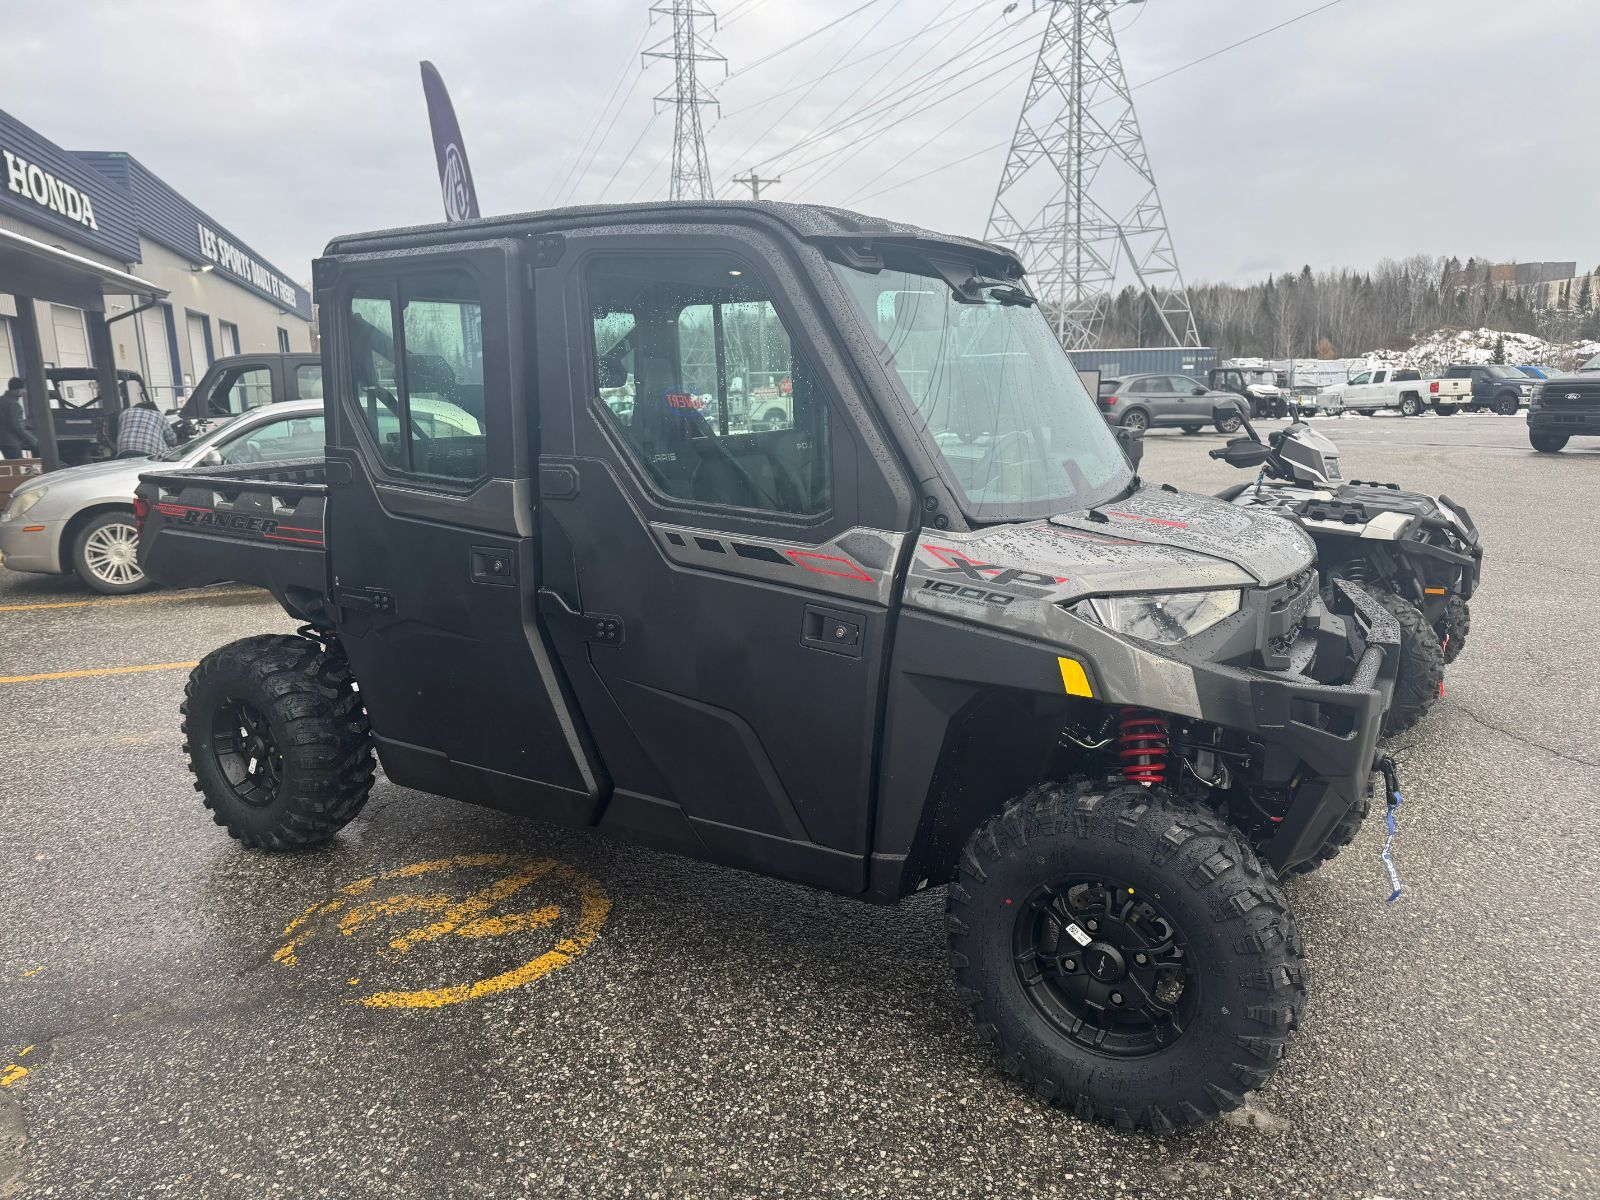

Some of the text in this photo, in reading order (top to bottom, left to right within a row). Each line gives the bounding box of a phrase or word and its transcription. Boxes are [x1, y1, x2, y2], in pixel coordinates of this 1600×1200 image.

[3, 151, 99, 231] HONDA
[197, 223, 218, 262] LES
[217, 237, 252, 282] SPORTS
[184, 509, 280, 534] RANGER
[924, 556, 1057, 587] XP
[919, 579, 1015, 606] 1000
